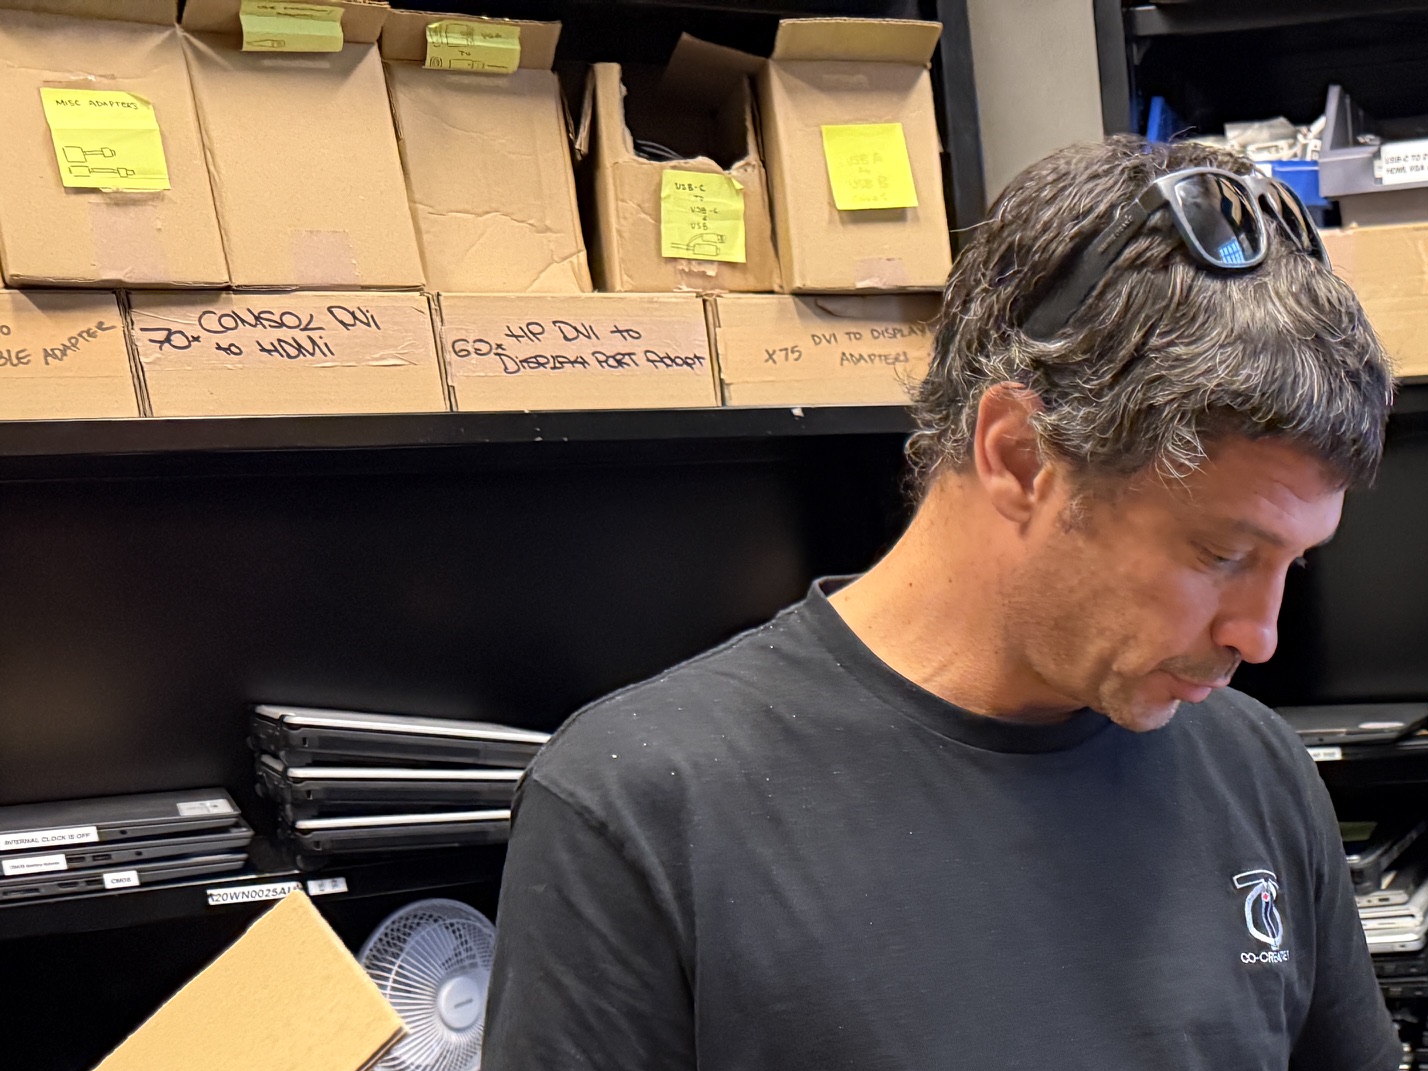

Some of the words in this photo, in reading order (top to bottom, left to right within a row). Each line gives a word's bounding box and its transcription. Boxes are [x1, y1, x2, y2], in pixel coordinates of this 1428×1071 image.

[55, 99, 81, 107] MISC
[88, 100, 138, 110] ADAPTERS
[505, 321, 545, 344] HP
[552, 320, 600, 342] DVI
[610, 324, 642, 341] to
[811, 332, 839, 346] DVI
[845, 331, 863, 341] TO
[43, 320, 118, 366] ADAPTER
[592, 351, 640, 371] PORT
[4, 836, 40, 846] INTERNAL
[41, 834, 66, 843] CLOCK
